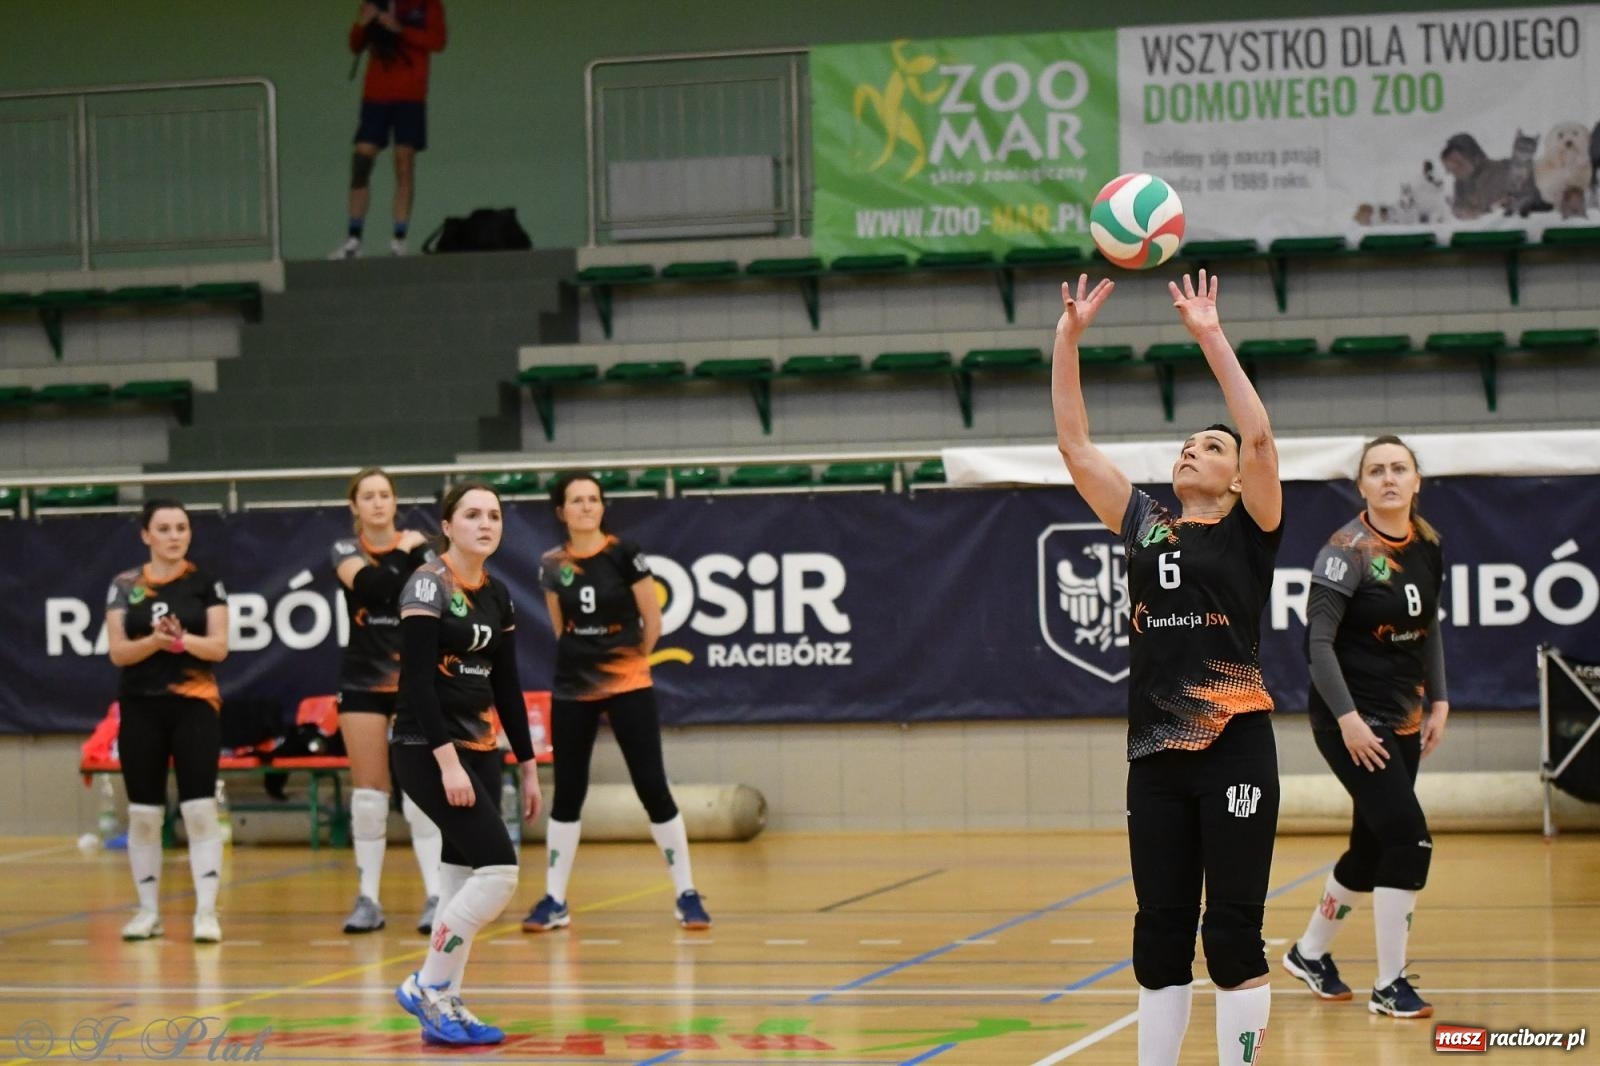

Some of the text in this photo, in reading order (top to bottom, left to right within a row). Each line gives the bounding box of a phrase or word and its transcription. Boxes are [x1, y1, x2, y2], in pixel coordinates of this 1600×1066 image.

[1141, 16, 1581, 76] WSZYSTKO DLA TWOJEGO
[938, 60, 1089, 113] ZOO
[1142, 72, 1444, 125] DOMOWEGO ZOO
[929, 112, 1087, 165] MAR
[1158, 550, 1181, 590] 6
[579, 586, 596, 613] 9
[1404, 584, 1421, 616] 8
[467, 624, 492, 651] 17
[1146, 612, 1202, 629] Fundacja
[708, 636, 853, 668] RACIBÓRZ
